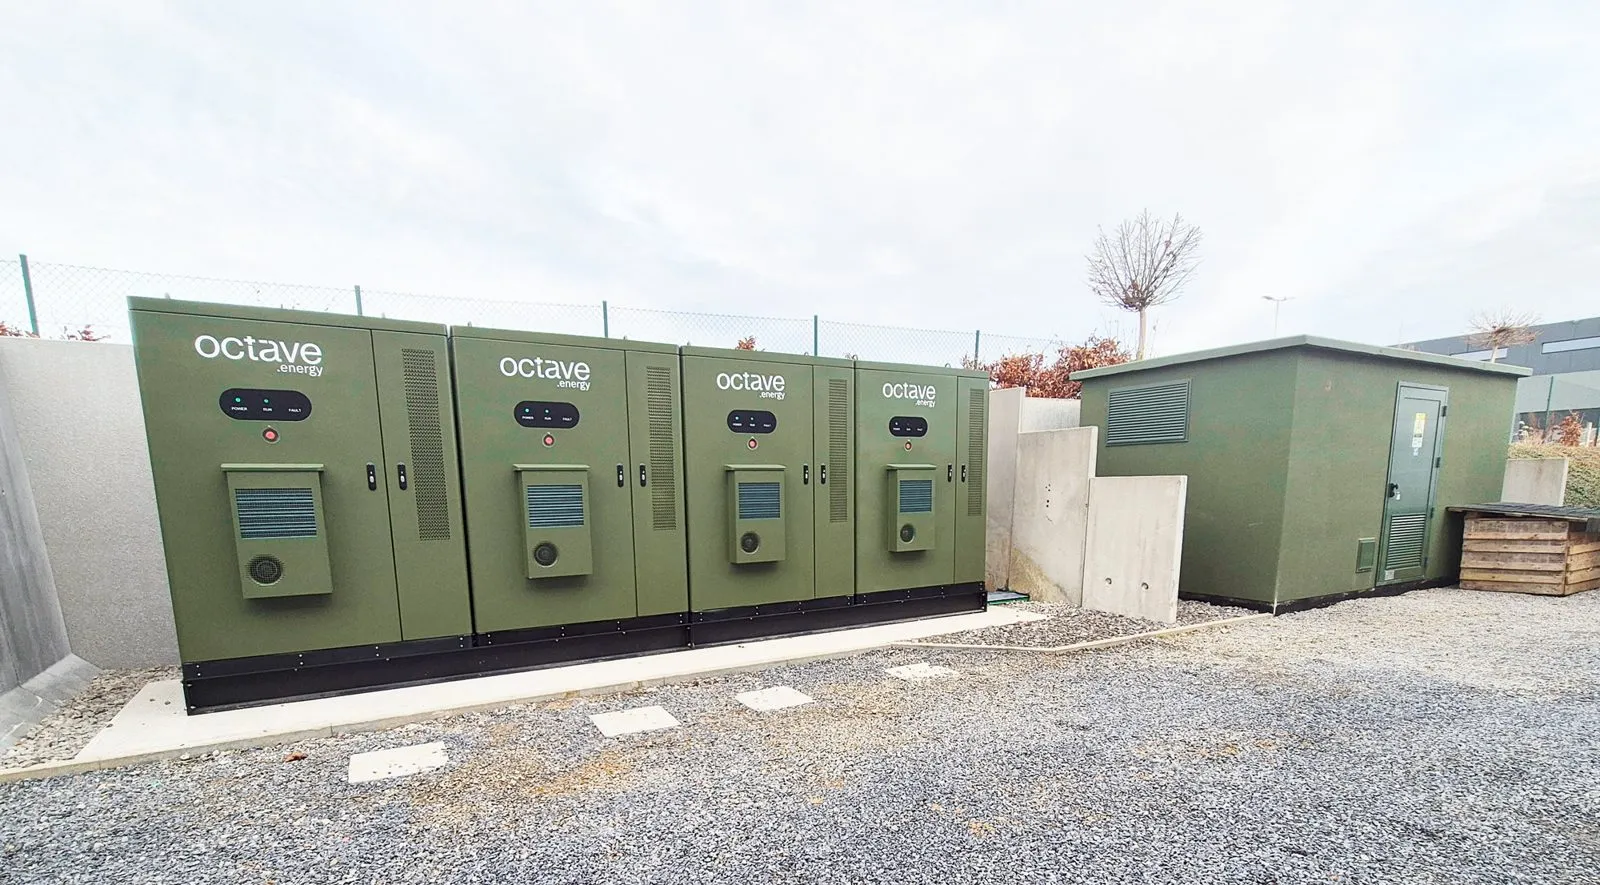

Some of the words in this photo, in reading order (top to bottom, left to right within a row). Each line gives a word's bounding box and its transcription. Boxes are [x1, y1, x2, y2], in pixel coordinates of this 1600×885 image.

[194, 335, 322, 364] octave
[277, 364, 323, 376] .energy
[500, 357, 590, 380] octave
[557, 380, 590, 390] .energy
[716, 372, 785, 391] octave
[760, 391, 786, 400] .energy
[882, 382, 936, 400] octave
